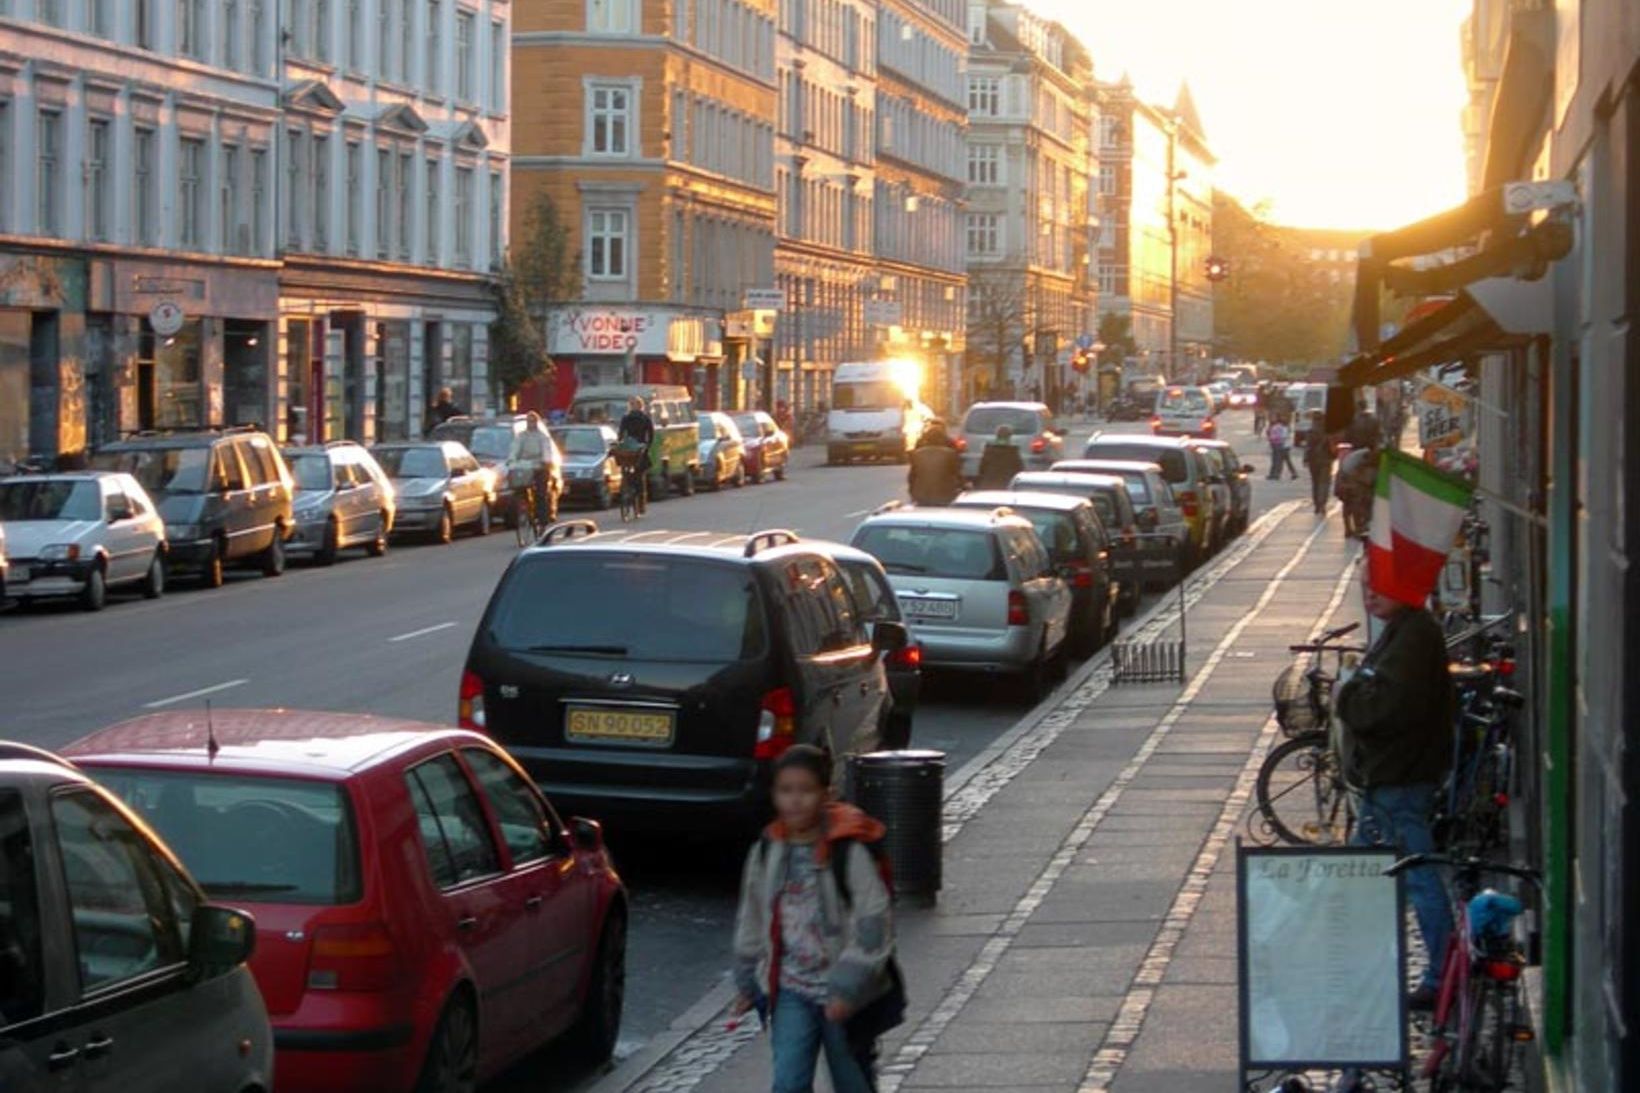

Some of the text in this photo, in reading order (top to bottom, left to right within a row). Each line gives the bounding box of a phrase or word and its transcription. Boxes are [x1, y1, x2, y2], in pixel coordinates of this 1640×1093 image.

[568, 311, 646, 332] YVONNE
[579, 334, 638, 349] VIDEO
[573, 713, 600, 731] SN
[603, 714, 628, 733] 90
